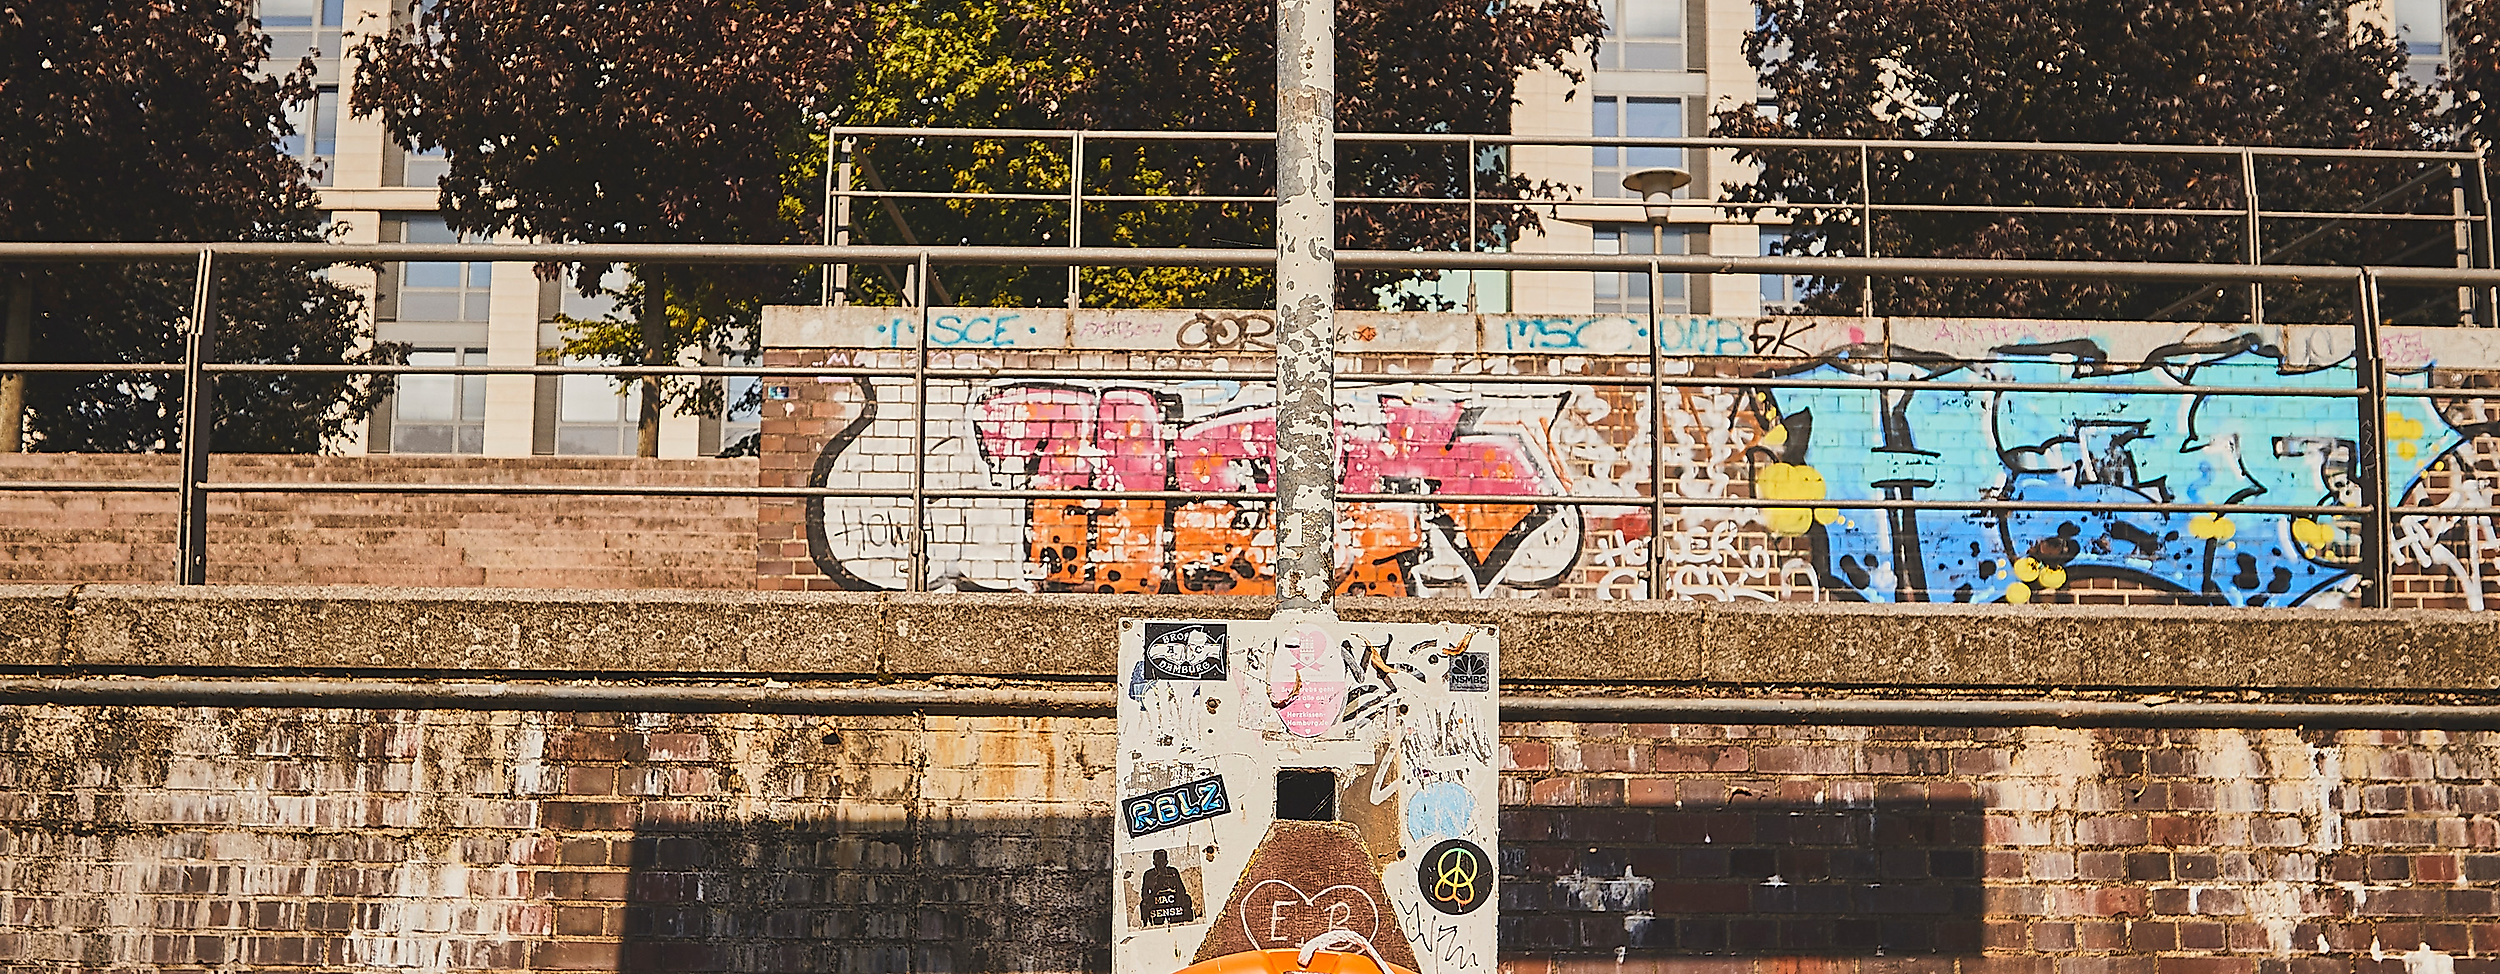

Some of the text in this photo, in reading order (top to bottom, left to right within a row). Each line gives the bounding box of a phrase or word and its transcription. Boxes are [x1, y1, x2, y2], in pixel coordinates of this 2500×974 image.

[1451, 675, 1487, 684] NSMBC
[1130, 781, 1224, 831] RBLZ
[1154, 894, 1175, 905] MAC
[1149, 906, 1184, 918] SENSE
[1270, 900, 1299, 942] E
